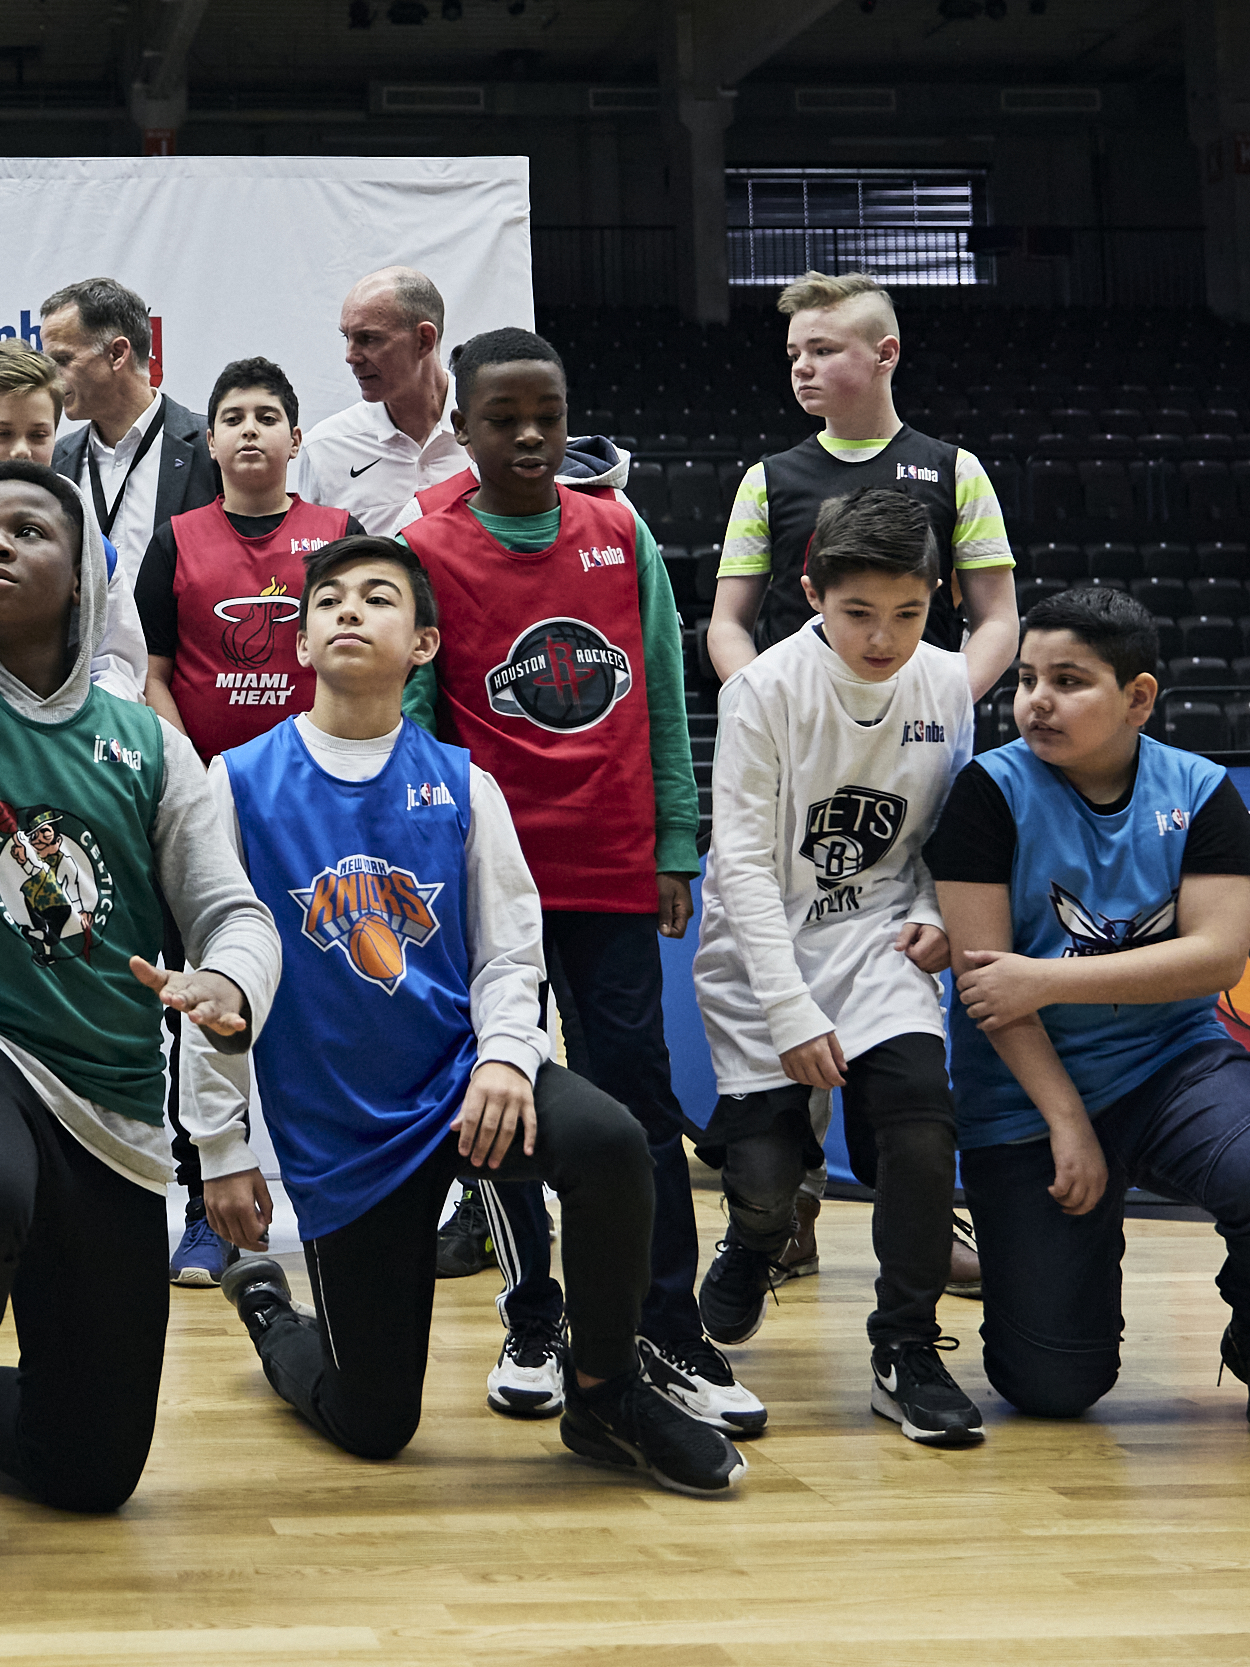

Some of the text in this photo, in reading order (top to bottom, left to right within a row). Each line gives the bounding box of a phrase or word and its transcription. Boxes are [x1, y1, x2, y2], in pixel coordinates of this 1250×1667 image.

[575, 648, 627, 670] ROCKETS
[215, 673, 289, 688] MIAMI
[493, 654, 546, 690] HOUSTON
[229, 685, 296, 705] HEAT
[339, 858, 387, 875] NEW ORK
[80, 830, 113, 926] CELTICS
[307, 871, 433, 931] KNICKS
